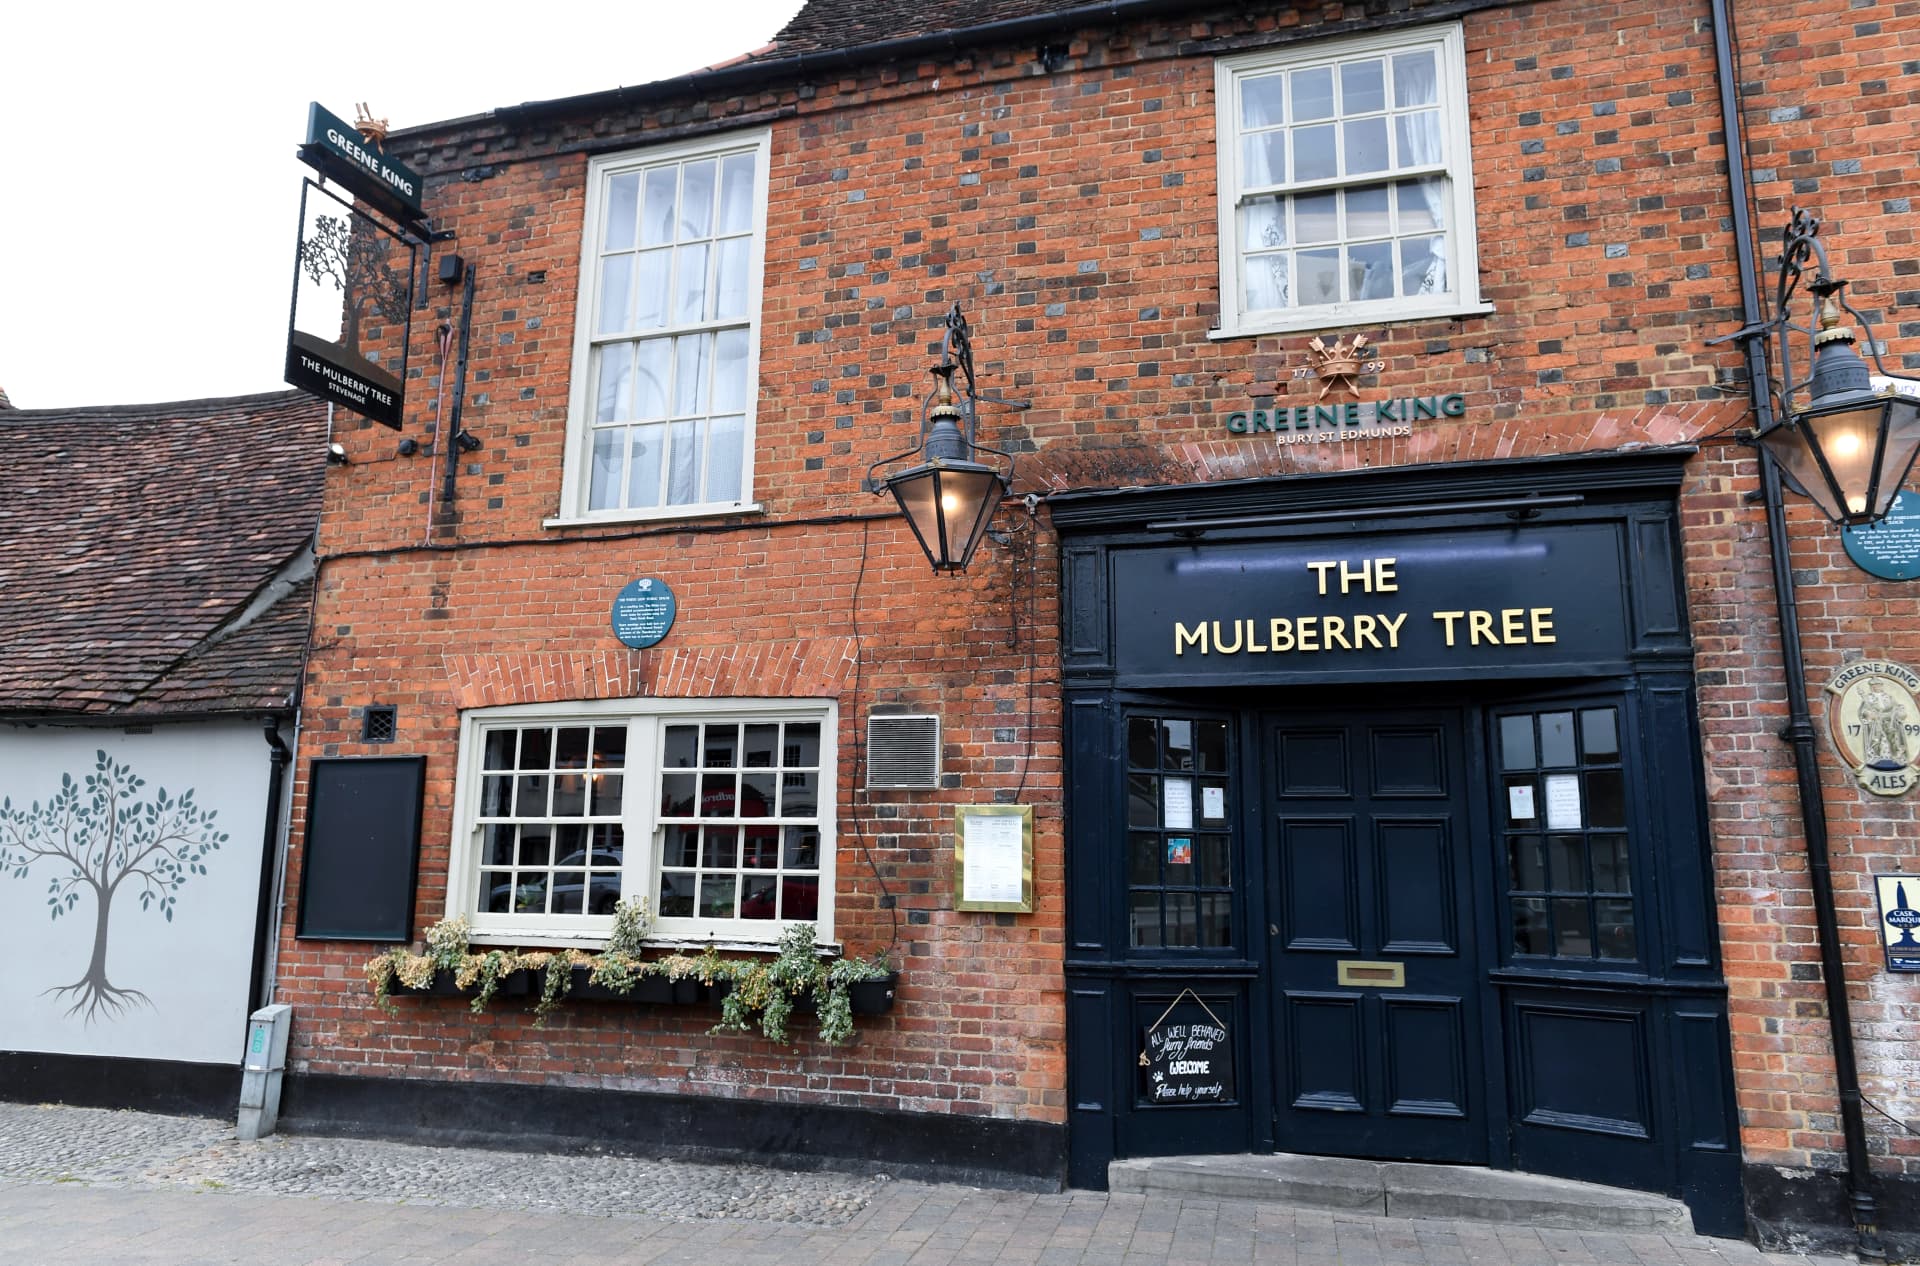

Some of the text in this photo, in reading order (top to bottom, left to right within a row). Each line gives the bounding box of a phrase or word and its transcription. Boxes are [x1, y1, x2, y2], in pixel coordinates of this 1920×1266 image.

[326, 128, 413, 197] GREENE KING
[301, 355, 392, 406] THE MULBERRY TREE
[1292, 361, 1386, 379] 17 99
[328, 382, 366, 405] STEVENAGE
[1226, 392, 1466, 435] GREENE KING
[1278, 425, 1411, 446] BURY ST EDMUNDS
[1307, 557, 1400, 596] THE
[1174, 607, 1558, 656] MULBERRY TREE
[1834, 663, 1919, 690] GREENE KING
[1847, 724, 1920, 737] 17 99
[1870, 774, 1907, 789] ALES
[1151, 1024, 1226, 1048] ALL WELL BEHAVED
[1155, 1036, 1214, 1062] furry friends
[1169, 1060, 1210, 1075] WELCOME
[1154, 1081, 1223, 1101] Please help yourself
